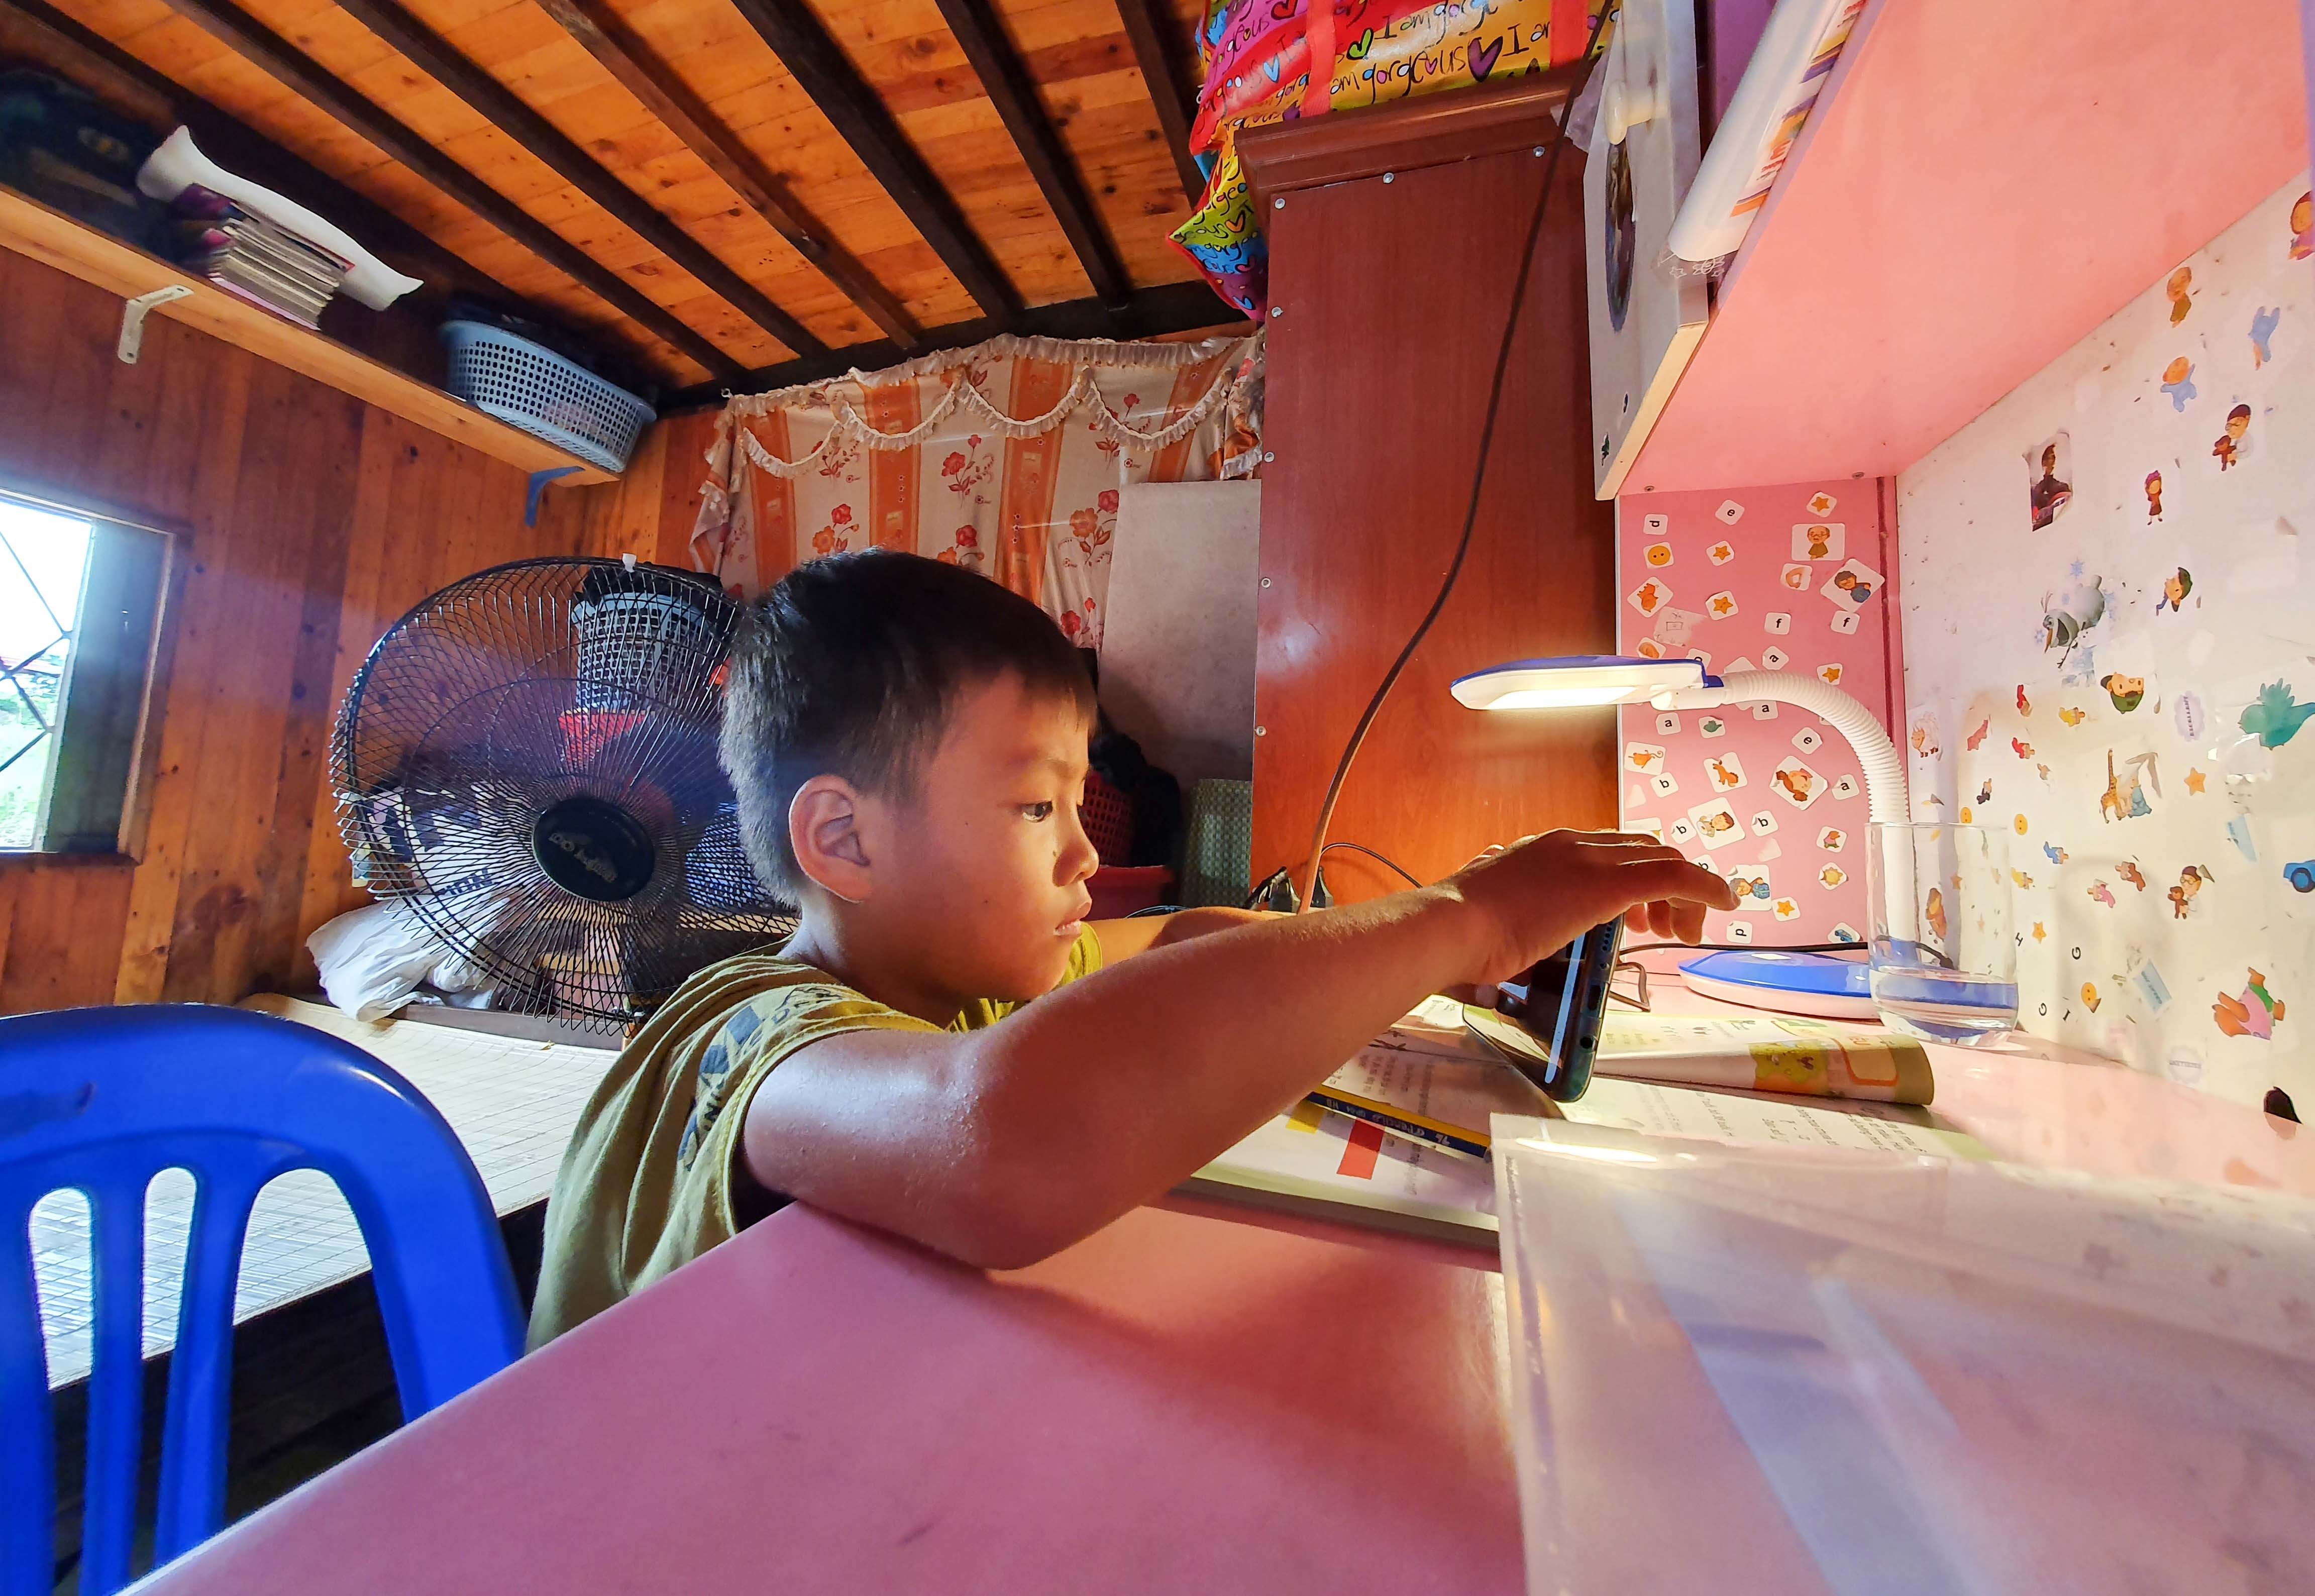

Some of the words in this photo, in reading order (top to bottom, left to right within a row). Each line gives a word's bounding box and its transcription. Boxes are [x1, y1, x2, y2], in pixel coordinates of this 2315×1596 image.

[1400, 10, 1431, 30] am
[1503, 23, 1529, 57] I
[1362, 47, 1466, 104] gorgeous
[1776, 618, 1782, 628] f
[1843, 617, 1850, 627] f
[1769, 655, 1779, 663] a
[1761, 704, 1769, 712] a
[1804, 736, 1812, 744] e
[1659, 779, 1669, 788] b
[1841, 782, 1850, 791] a
[1758, 817, 1768, 827] b
[1676, 825, 1687, 834] b
